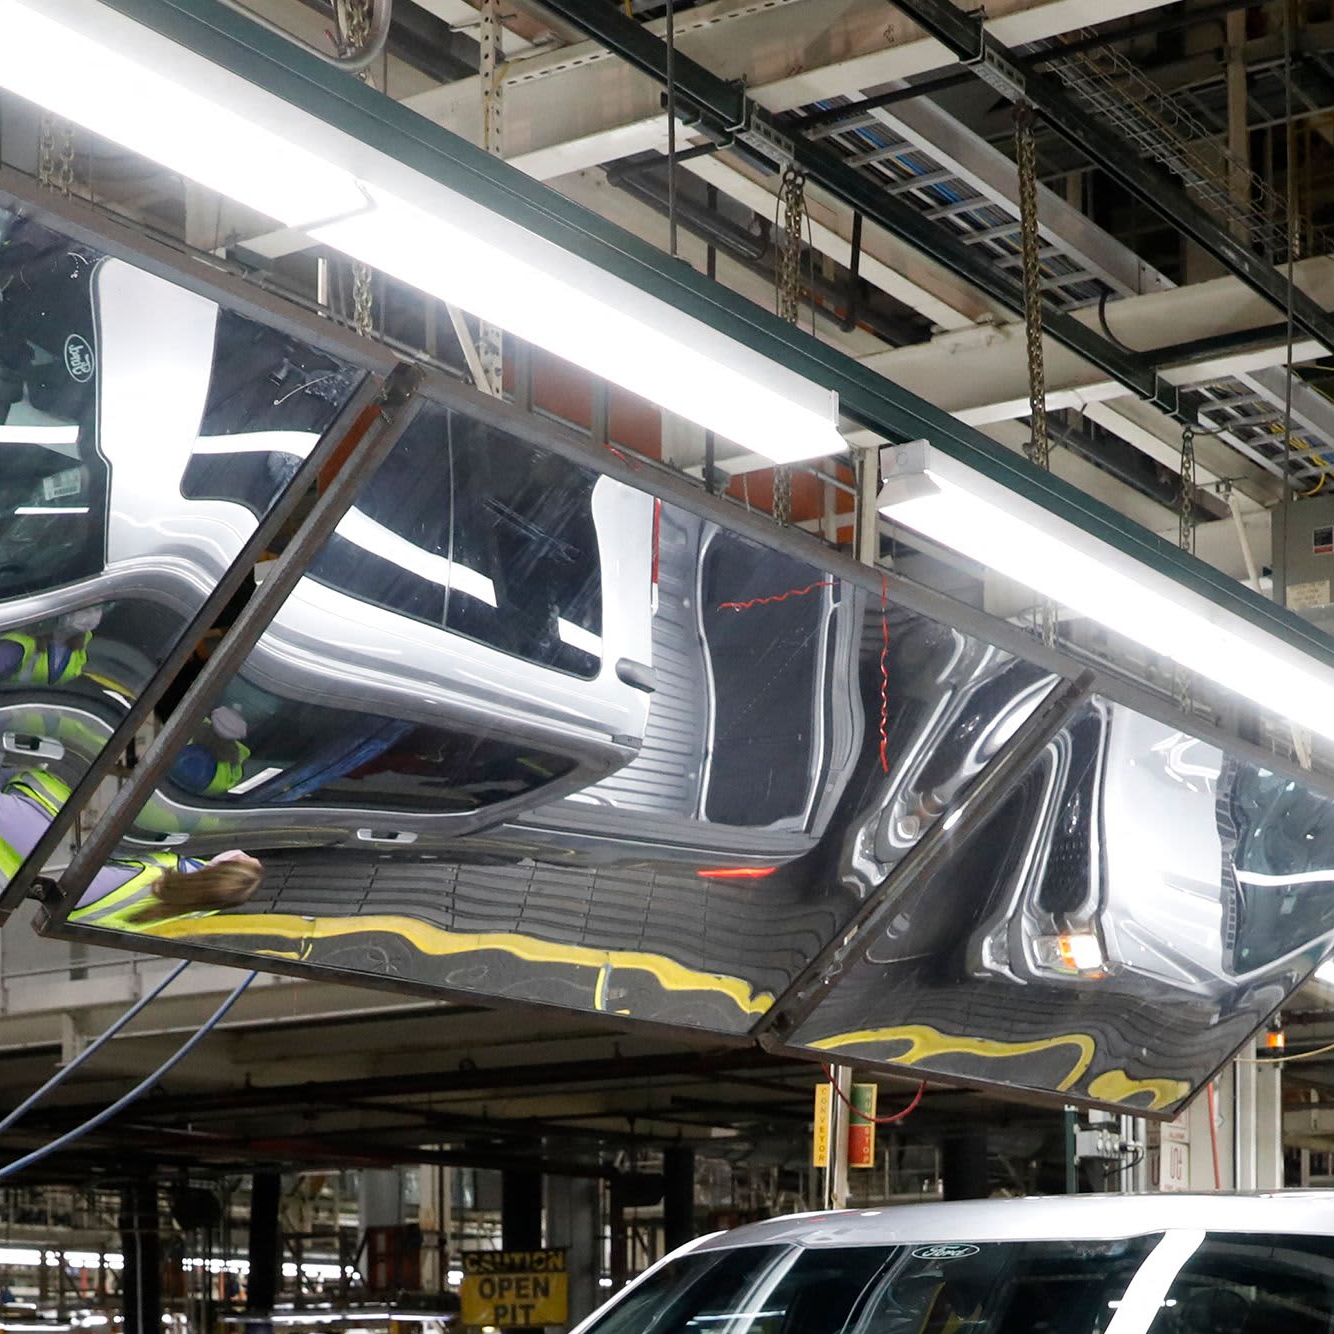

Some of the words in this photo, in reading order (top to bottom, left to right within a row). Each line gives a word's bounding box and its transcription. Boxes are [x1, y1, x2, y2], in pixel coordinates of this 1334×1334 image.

[819, 1087, 828, 1162] CONVEYOR
[922, 1245, 969, 1257] Ford
[479, 1277, 550, 1299] OPEN
[494, 1304, 535, 1327] PIT
